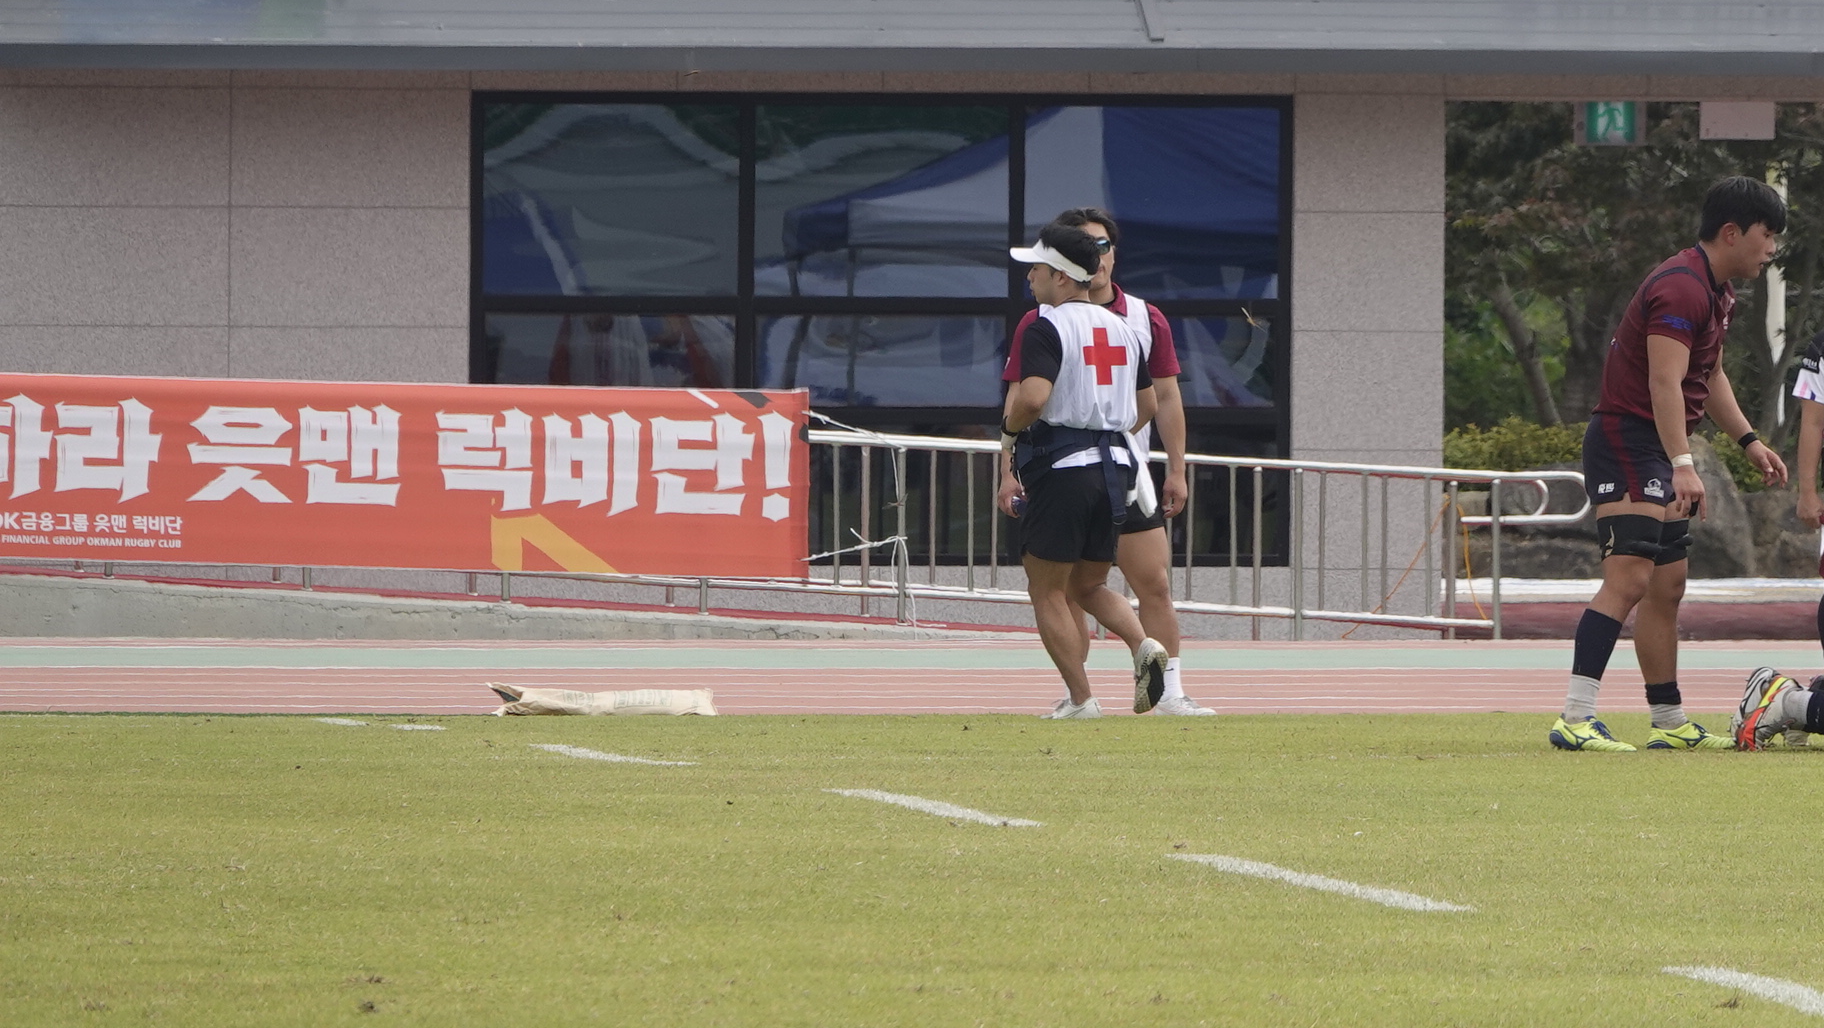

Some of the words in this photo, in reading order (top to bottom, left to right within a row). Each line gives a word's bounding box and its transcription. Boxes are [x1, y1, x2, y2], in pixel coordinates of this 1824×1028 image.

[185, 403, 402, 507] 읏맨
[436, 400, 794, 522] 럭비단!
[93, 513, 127, 534] 읏맨
[132, 515, 183, 535] 럭비단
[2, 534, 50, 545] FINANCIAL
[52, 535, 85, 546] GROUP
[86, 536, 122, 547] OKMAN
[124, 537, 156, 548] RUGBY
[158, 539, 182, 549] CLUB
